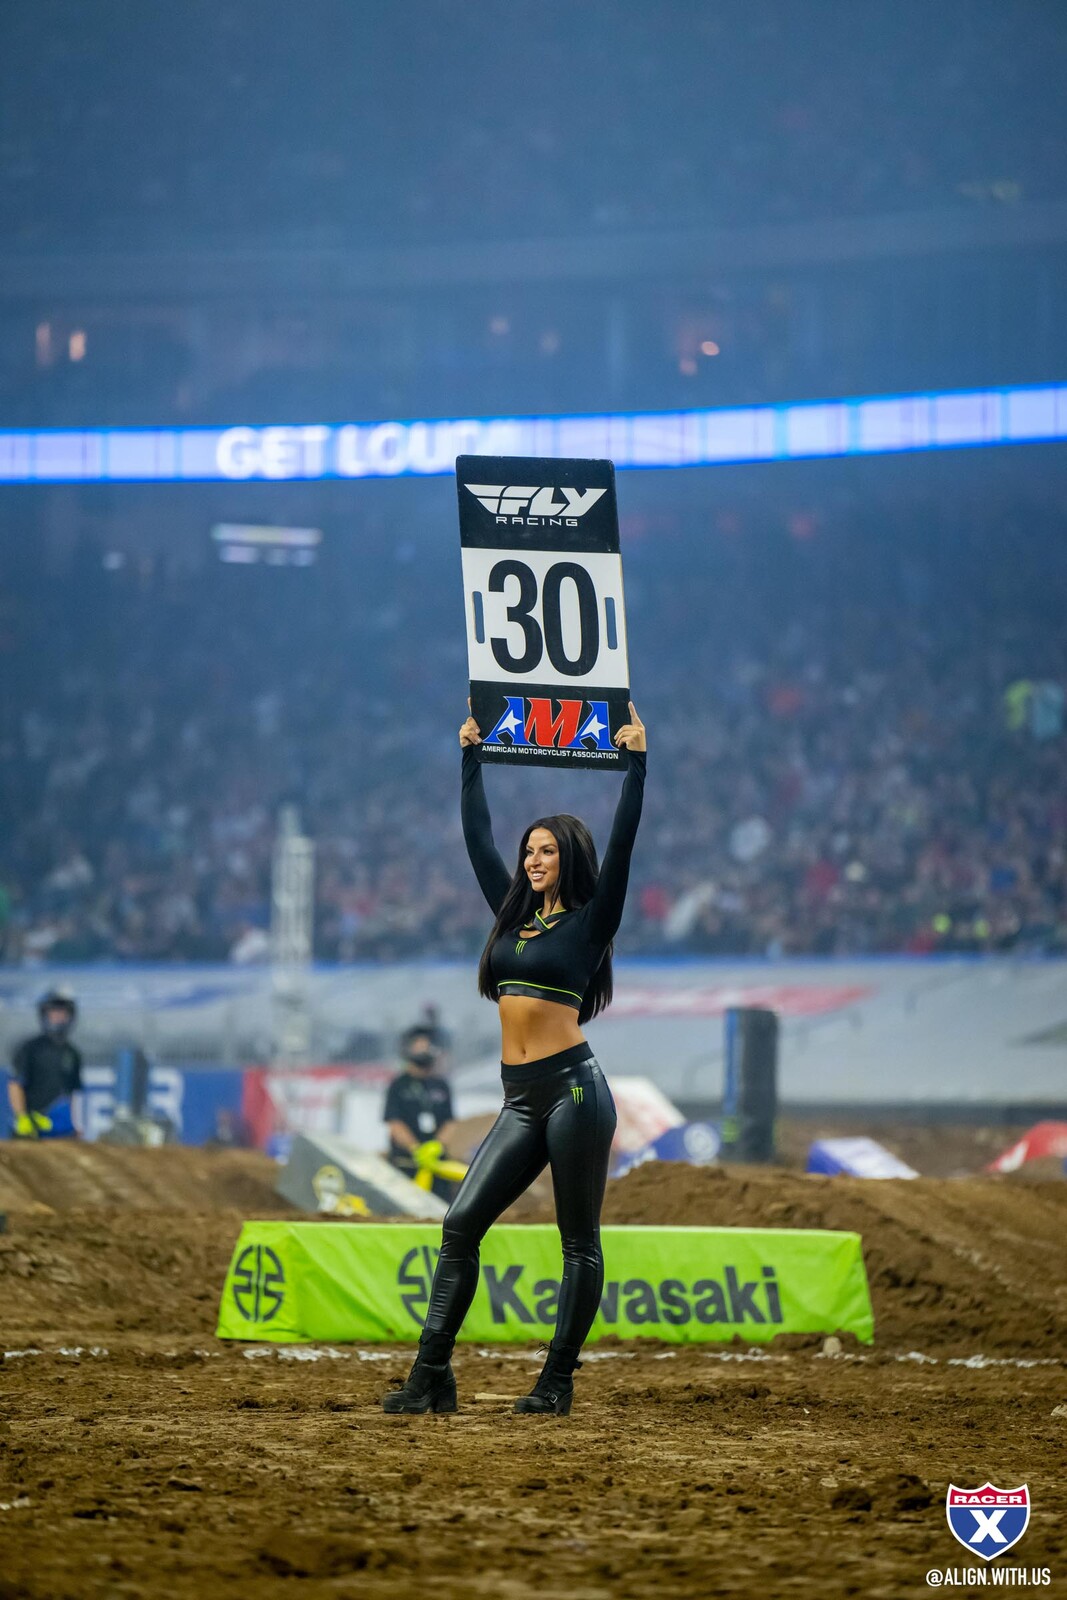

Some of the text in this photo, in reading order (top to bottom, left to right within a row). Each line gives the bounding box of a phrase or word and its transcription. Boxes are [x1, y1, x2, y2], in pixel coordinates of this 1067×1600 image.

[216, 425, 330, 479] GET
[463, 483, 608, 517] FLY
[495, 516, 578, 527] RACING
[488, 559, 599, 676] 30
[481, 695, 619, 751] AMA
[481, 745, 619, 760] AMERICAN MOTORCYCLIST ASSOCIATION
